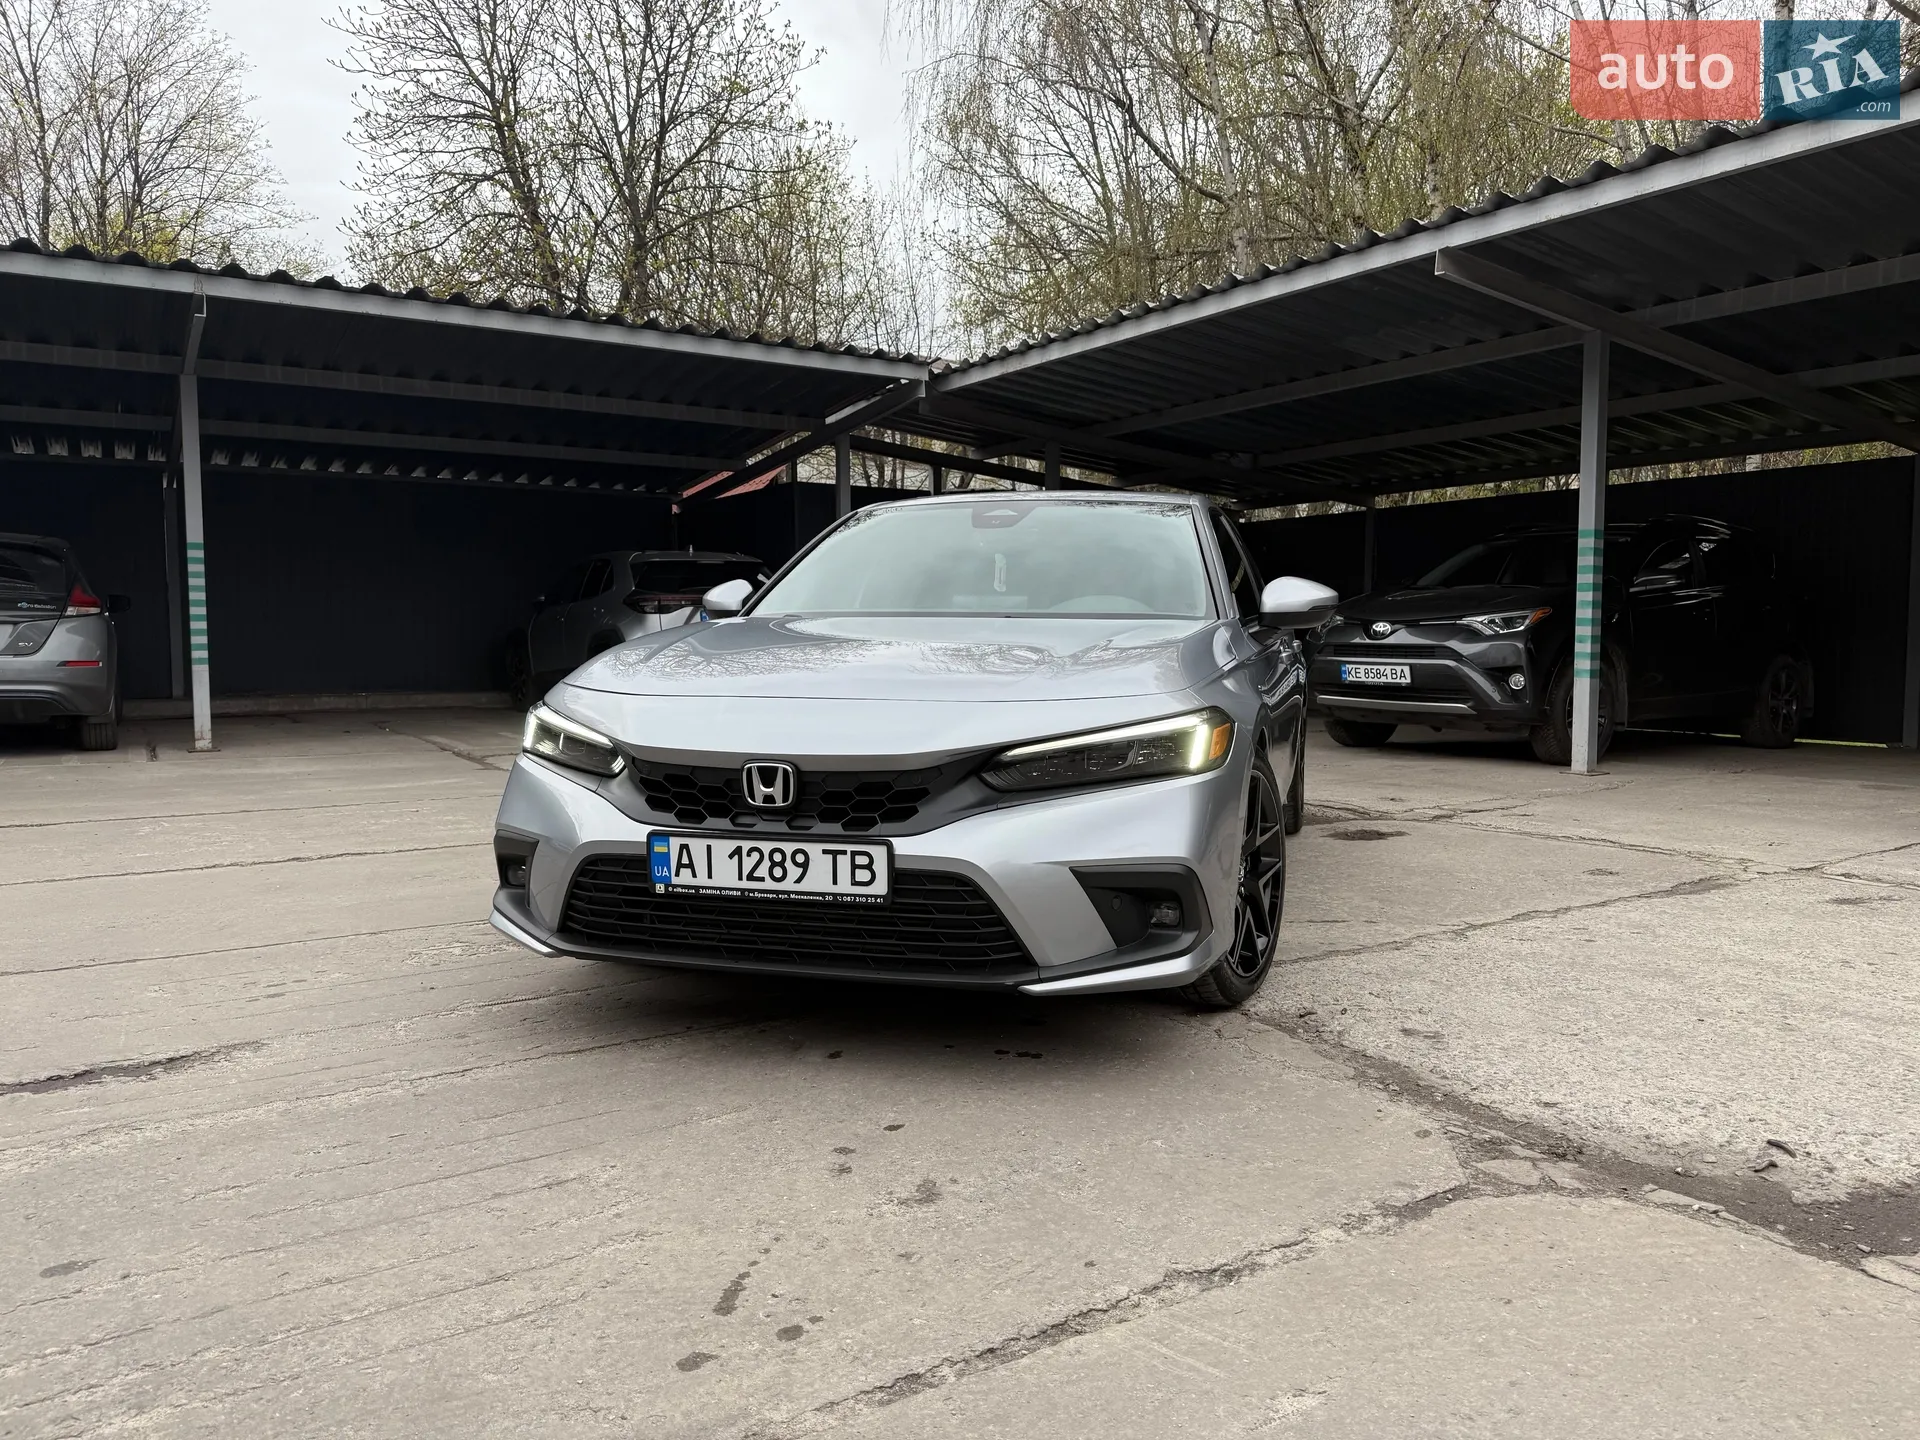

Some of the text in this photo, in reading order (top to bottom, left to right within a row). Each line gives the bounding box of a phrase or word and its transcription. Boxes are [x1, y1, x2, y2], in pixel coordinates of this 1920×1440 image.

[1347, 667, 1362, 679] KE
[1364, 668, 1388, 680] 8584
[1390, 668, 1407, 680] BA
[655, 865, 669, 877] UA
[674, 843, 877, 887] AI 1289 TB
